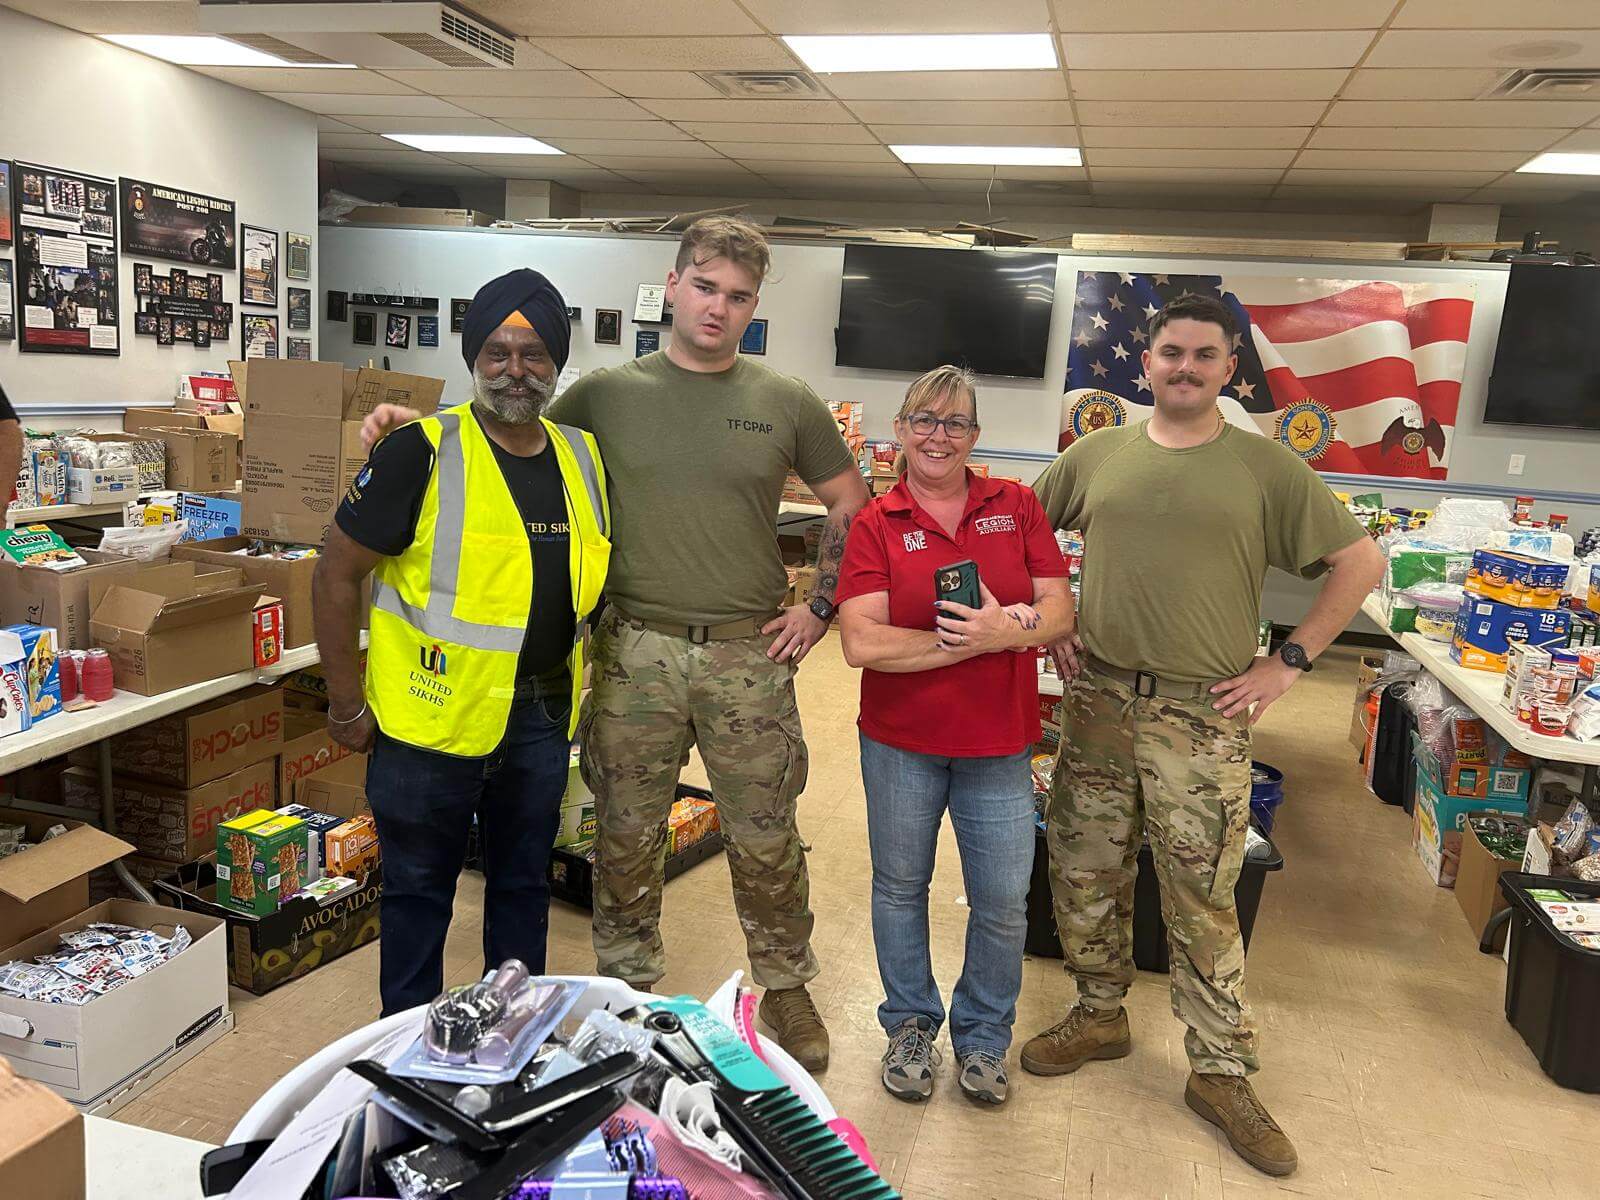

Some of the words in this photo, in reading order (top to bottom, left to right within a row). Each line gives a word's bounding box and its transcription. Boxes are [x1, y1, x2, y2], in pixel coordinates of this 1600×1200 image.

[152, 188, 186, 203] AMERICAN
[187, 194, 209, 207] LEGION
[209, 199, 232, 212] RIDERS
[176, 202, 195, 211] POST
[1077, 396, 1121, 416] AMERICAN
[726, 418, 741, 430] TF
[184, 506, 229, 522] FREEZER
[975, 517, 1016, 530] LEGION
[903, 533, 914, 542] BE
[979, 526, 1017, 536] AUXILIARY
[7, 533, 51, 547] chewy
[904, 540, 928, 553] ONE
[1540, 613, 1556, 625] 18
[409, 671, 452, 696] UNITED
[409, 686, 445, 707] SIKHS
[201, 711, 281, 763] snack
